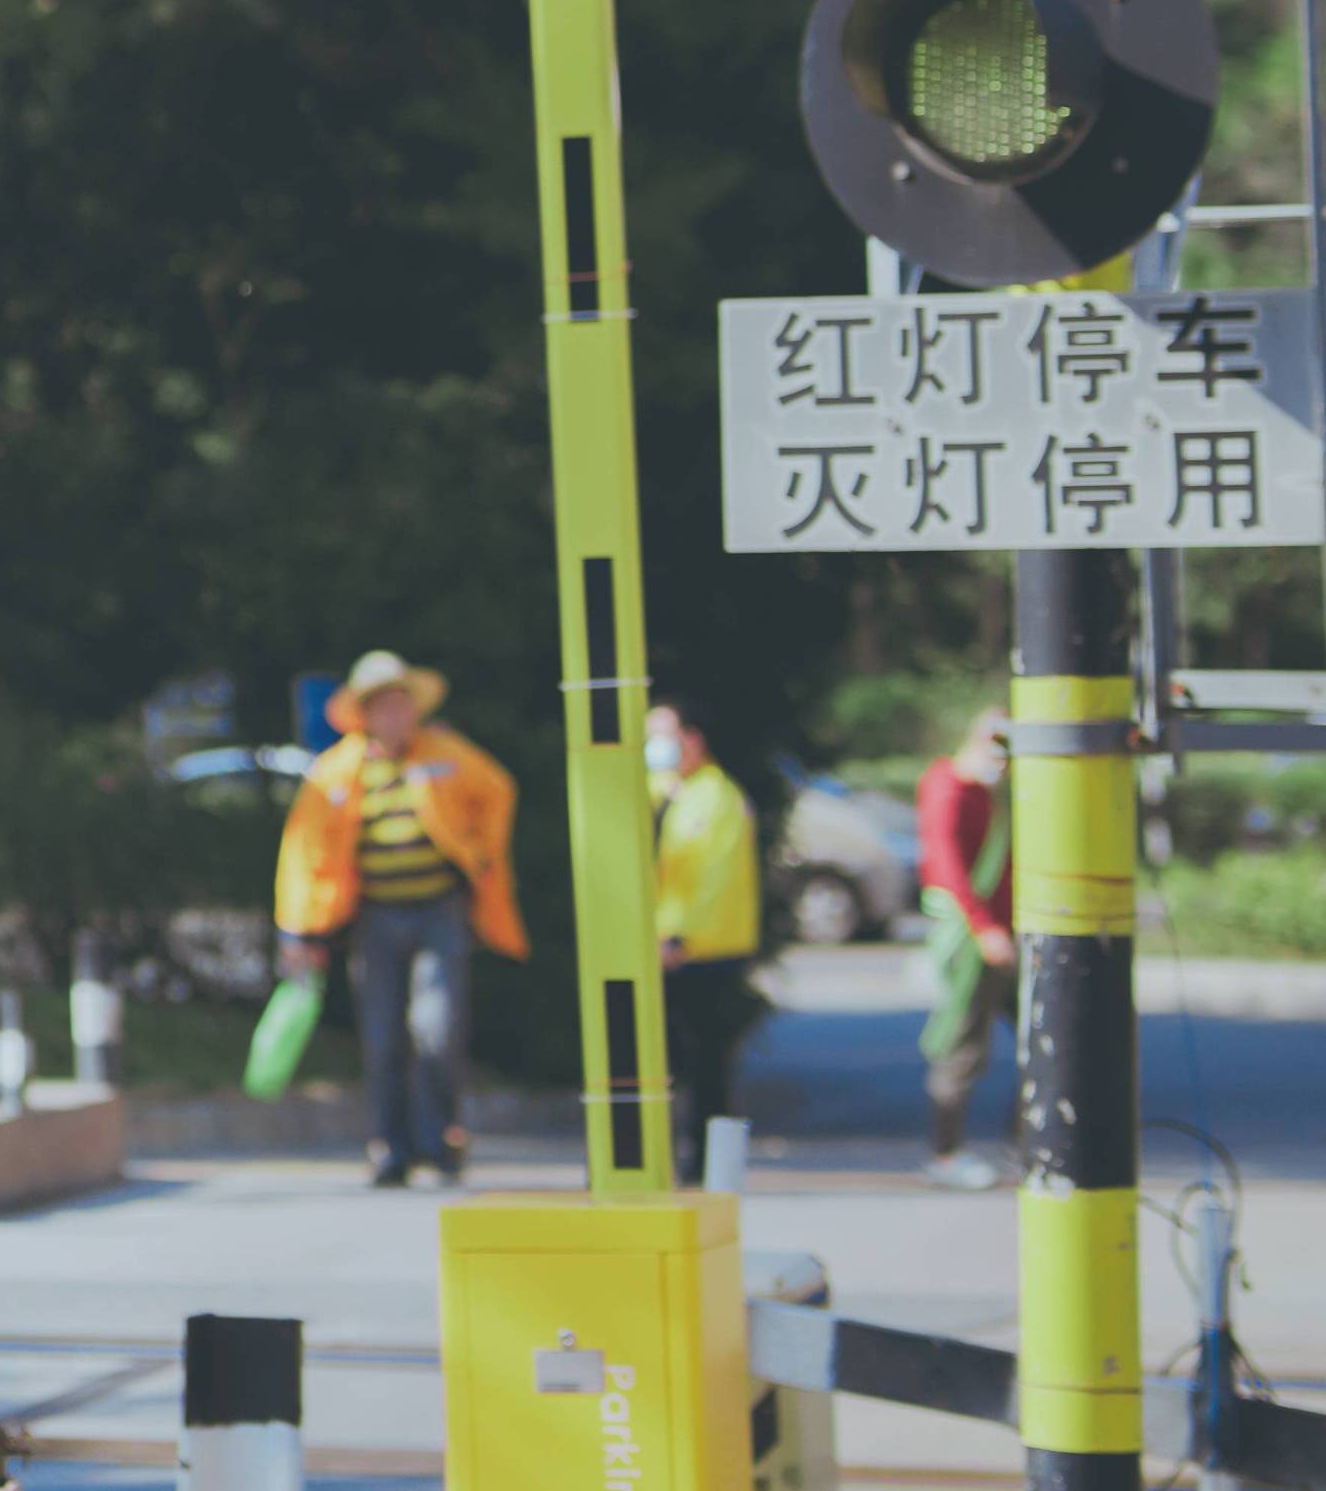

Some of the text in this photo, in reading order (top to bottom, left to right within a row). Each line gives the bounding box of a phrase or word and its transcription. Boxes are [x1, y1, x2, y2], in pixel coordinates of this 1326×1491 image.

[774, 295, 1262, 408] 红灯停车
[777, 428, 1264, 538] 灭灯停用
